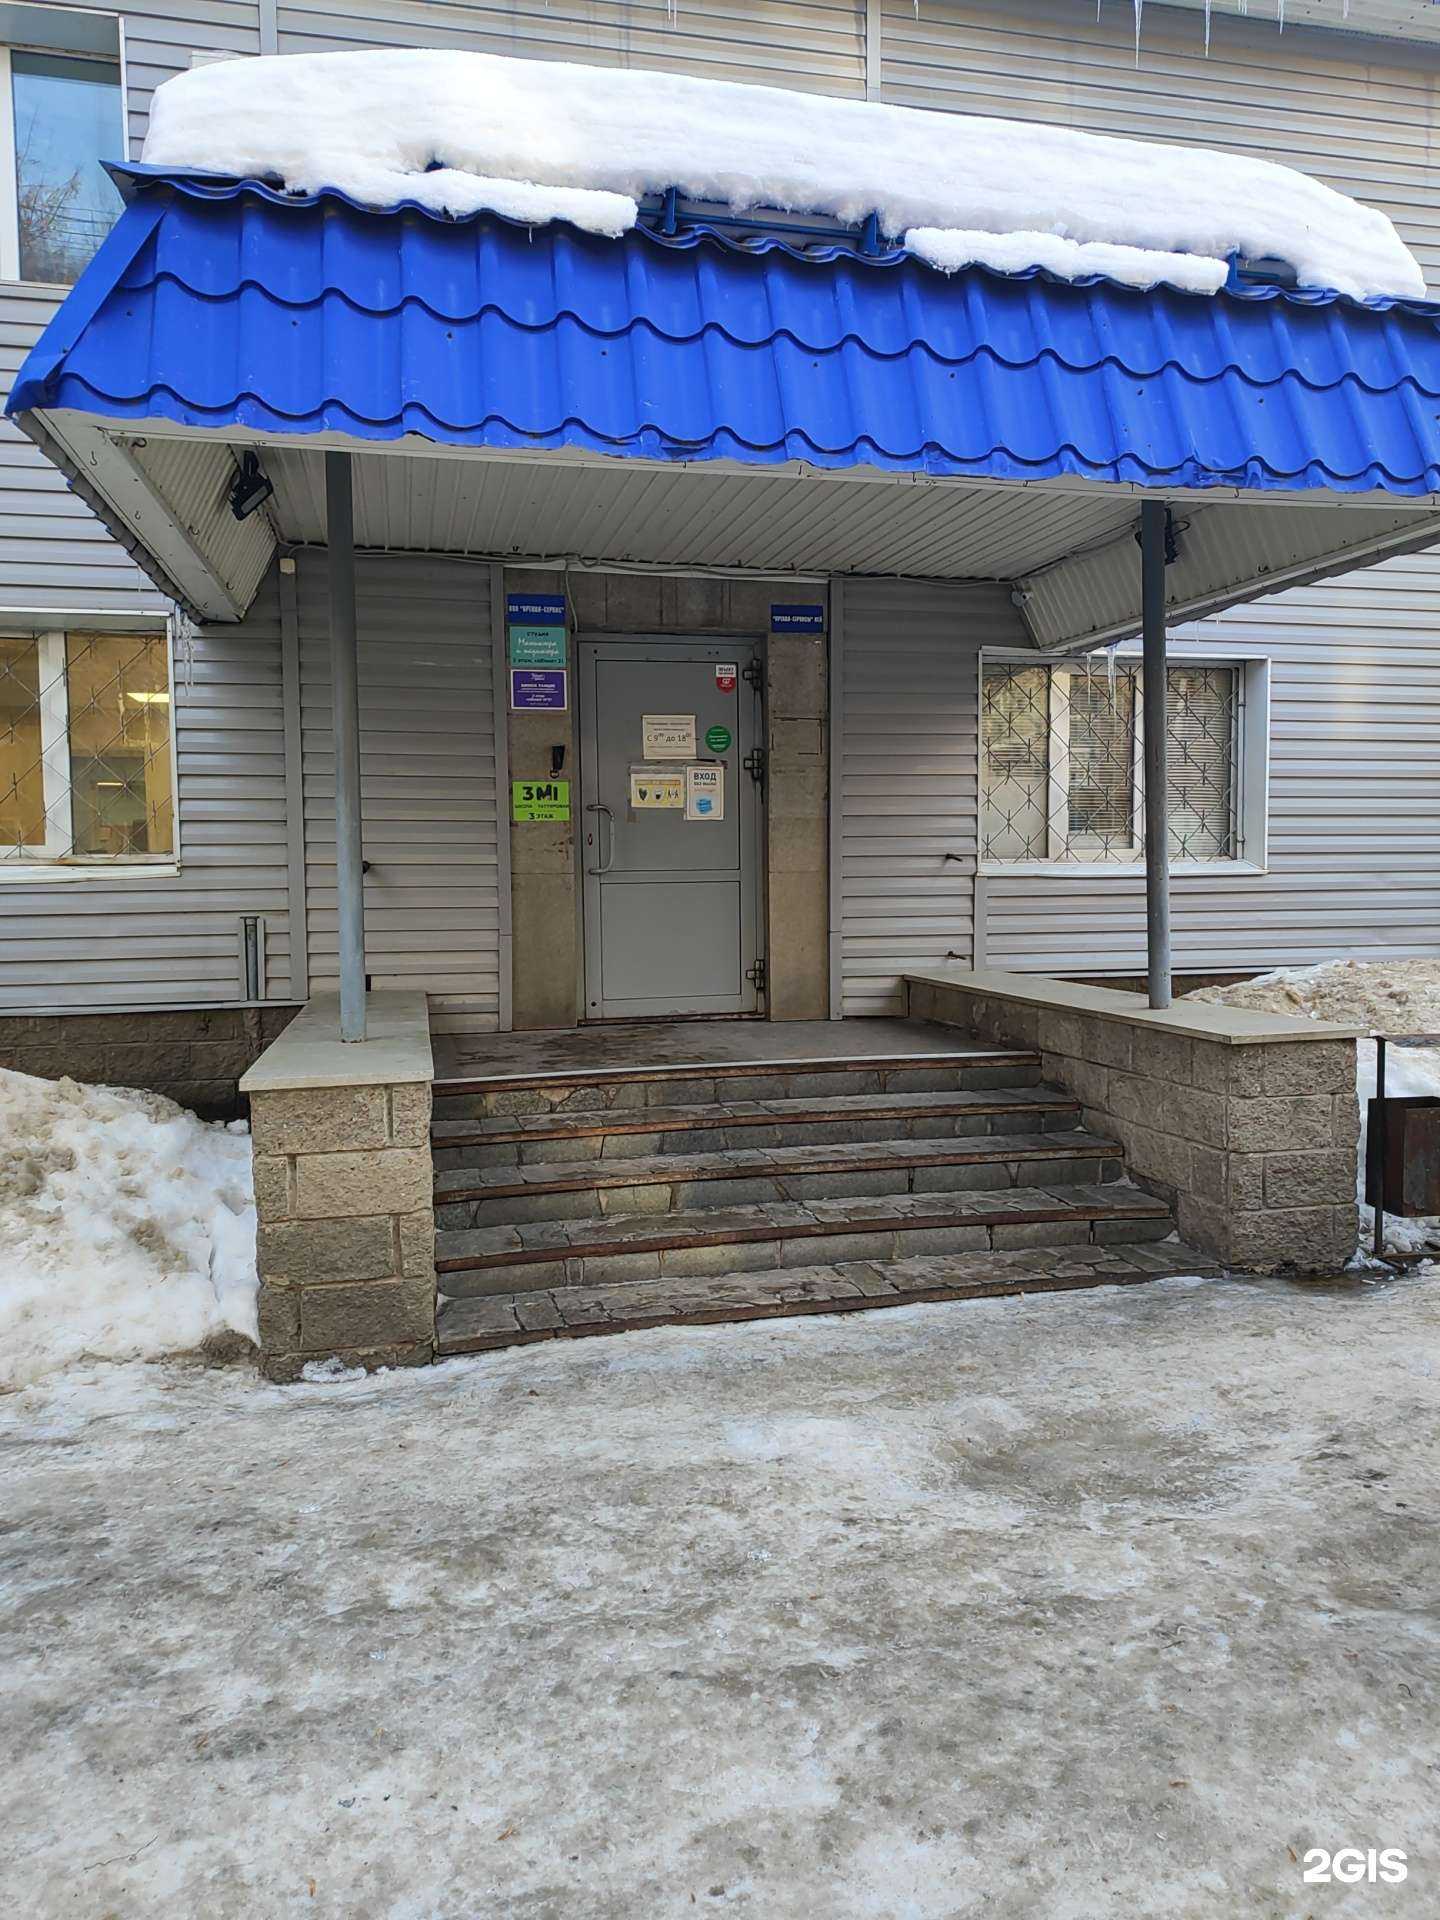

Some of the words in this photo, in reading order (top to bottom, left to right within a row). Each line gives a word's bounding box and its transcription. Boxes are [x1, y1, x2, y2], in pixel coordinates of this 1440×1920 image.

[665, 735, 676, 743] до
[693, 772, 717, 781] ВХОД
[528, 812, 535, 820] 3
